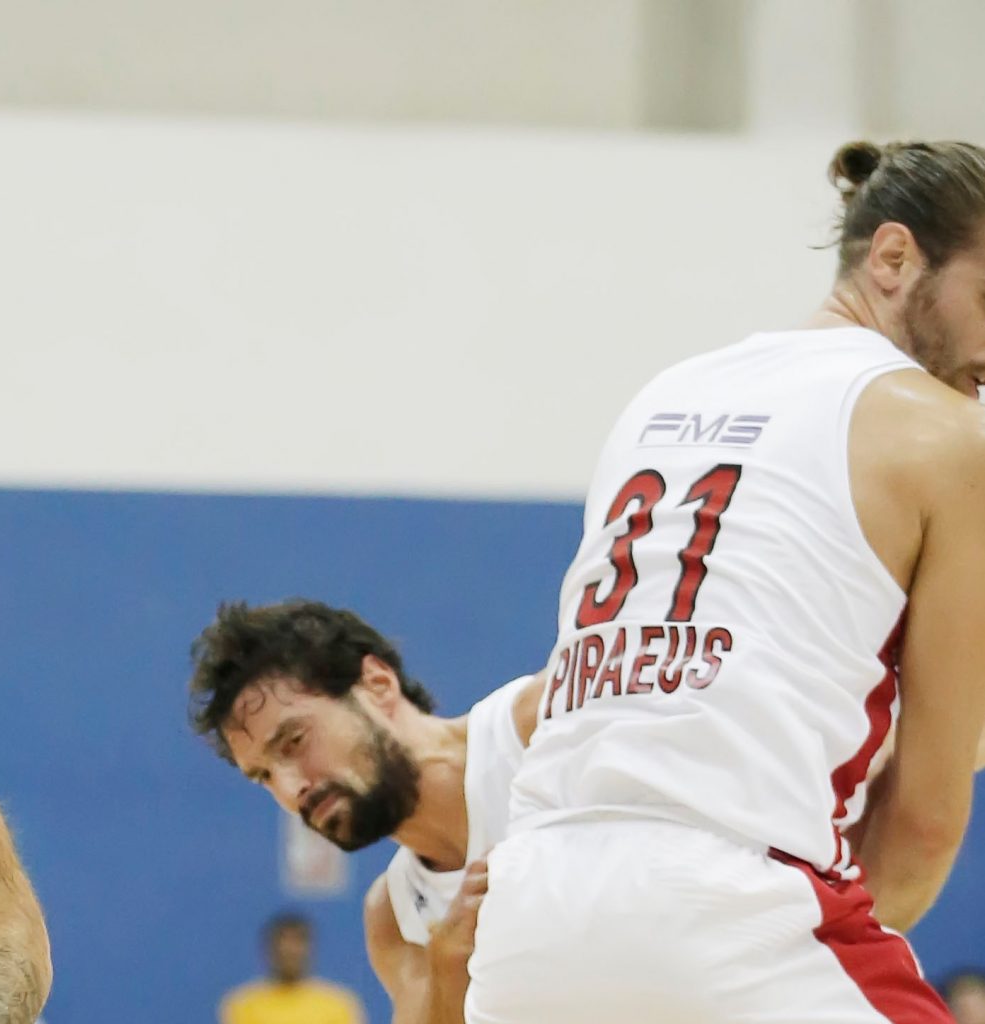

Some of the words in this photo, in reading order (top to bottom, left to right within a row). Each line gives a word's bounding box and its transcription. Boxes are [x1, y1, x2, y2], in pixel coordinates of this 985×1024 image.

[638, 413, 771, 443] FMS
[575, 463, 742, 630] 31
[544, 626, 733, 720] PIRAEUS
